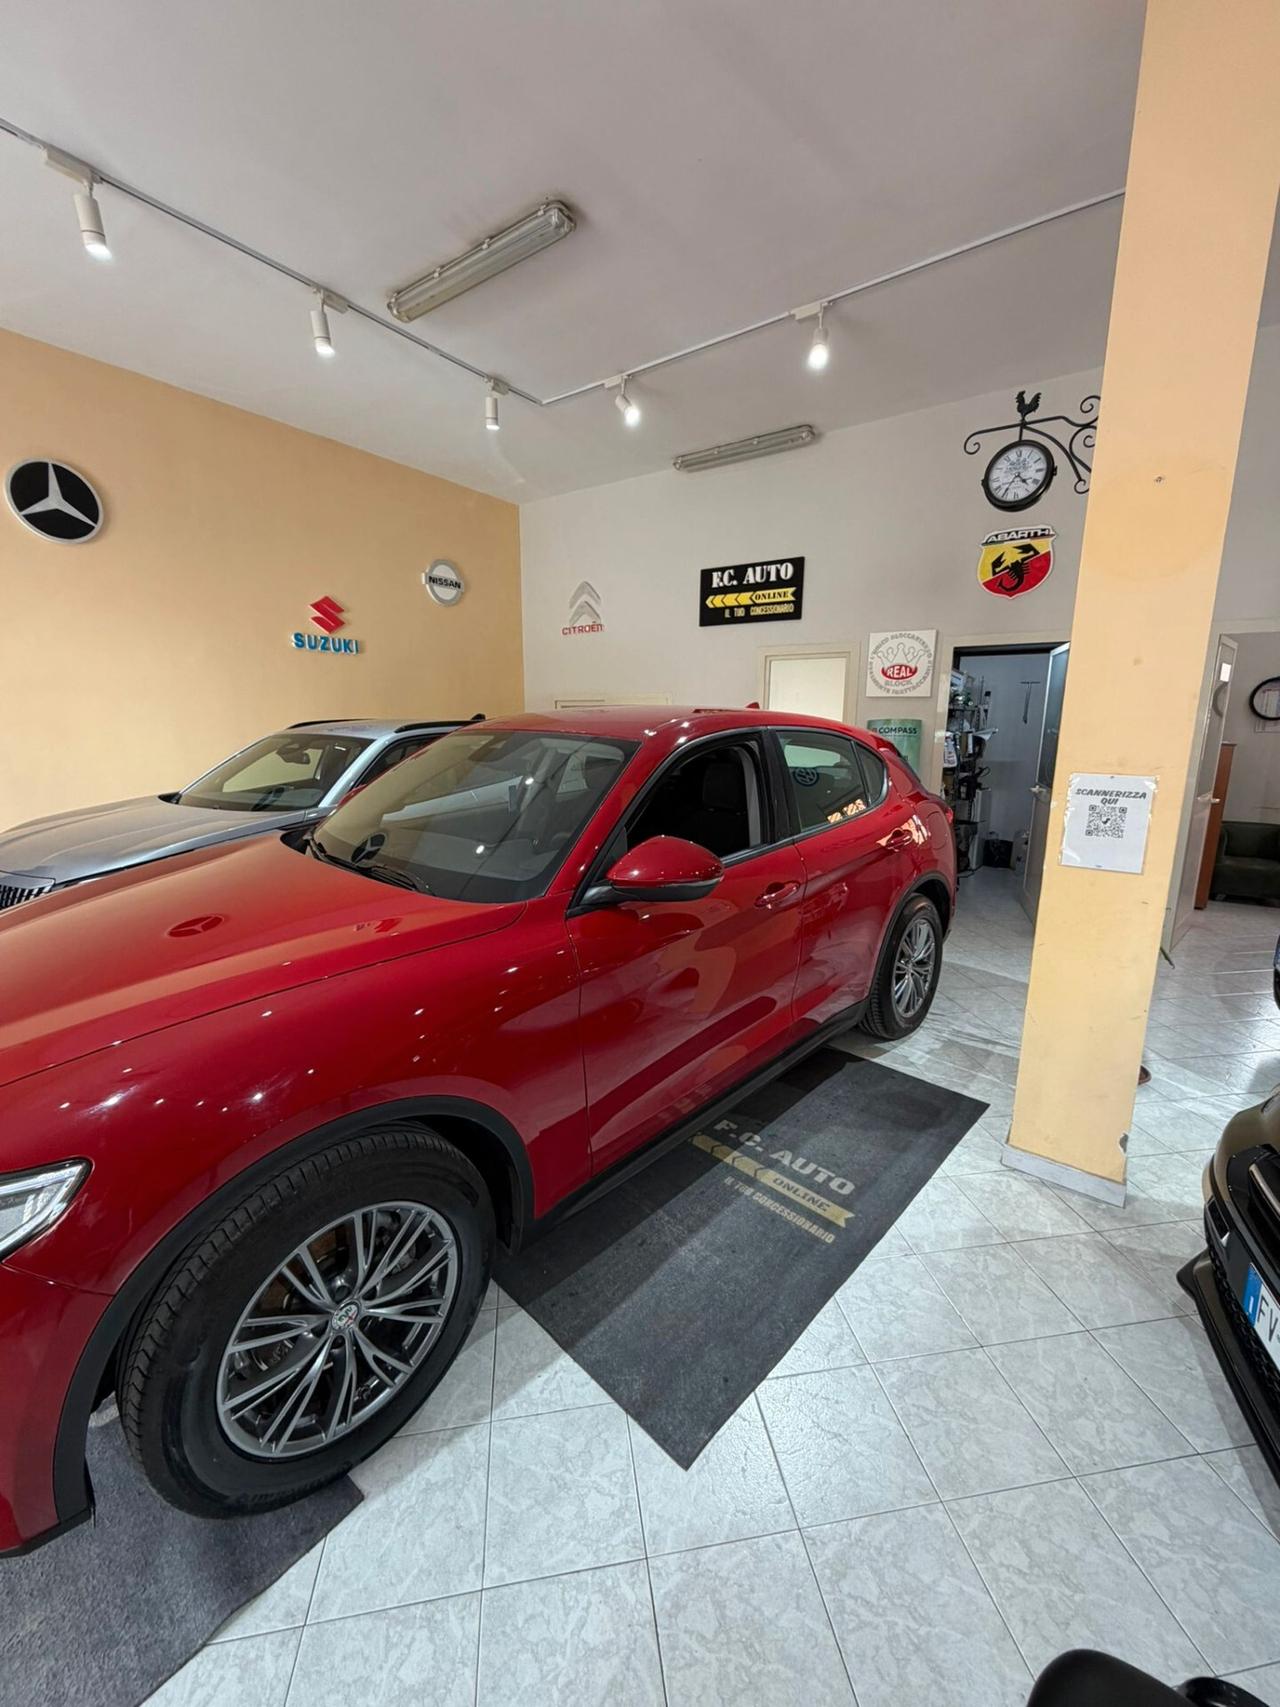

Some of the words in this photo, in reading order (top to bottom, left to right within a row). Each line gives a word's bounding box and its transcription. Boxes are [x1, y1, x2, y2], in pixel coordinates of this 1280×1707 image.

[987, 528, 1050, 542] ABARTH
[428, 575, 461, 589] NISSAN
[711, 569, 738, 588] F.C.
[742, 562, 794, 584] AUTO
[754, 590, 789, 601] ONLINE
[292, 632, 360, 655] SUZUKI
[886, 665, 914, 678] REAL
[878, 726, 918, 735] COMPASS
[1075, 788, 1147, 800] SCANNERIZZA
[1100, 797, 1119, 806] QUI
[769, 1150, 856, 1196] AUTO
[772, 1177, 831, 1213] ONLINE
[733, 1181, 755, 1197] TUO
[752, 1192, 836, 1244] CONCESSIONARIO
